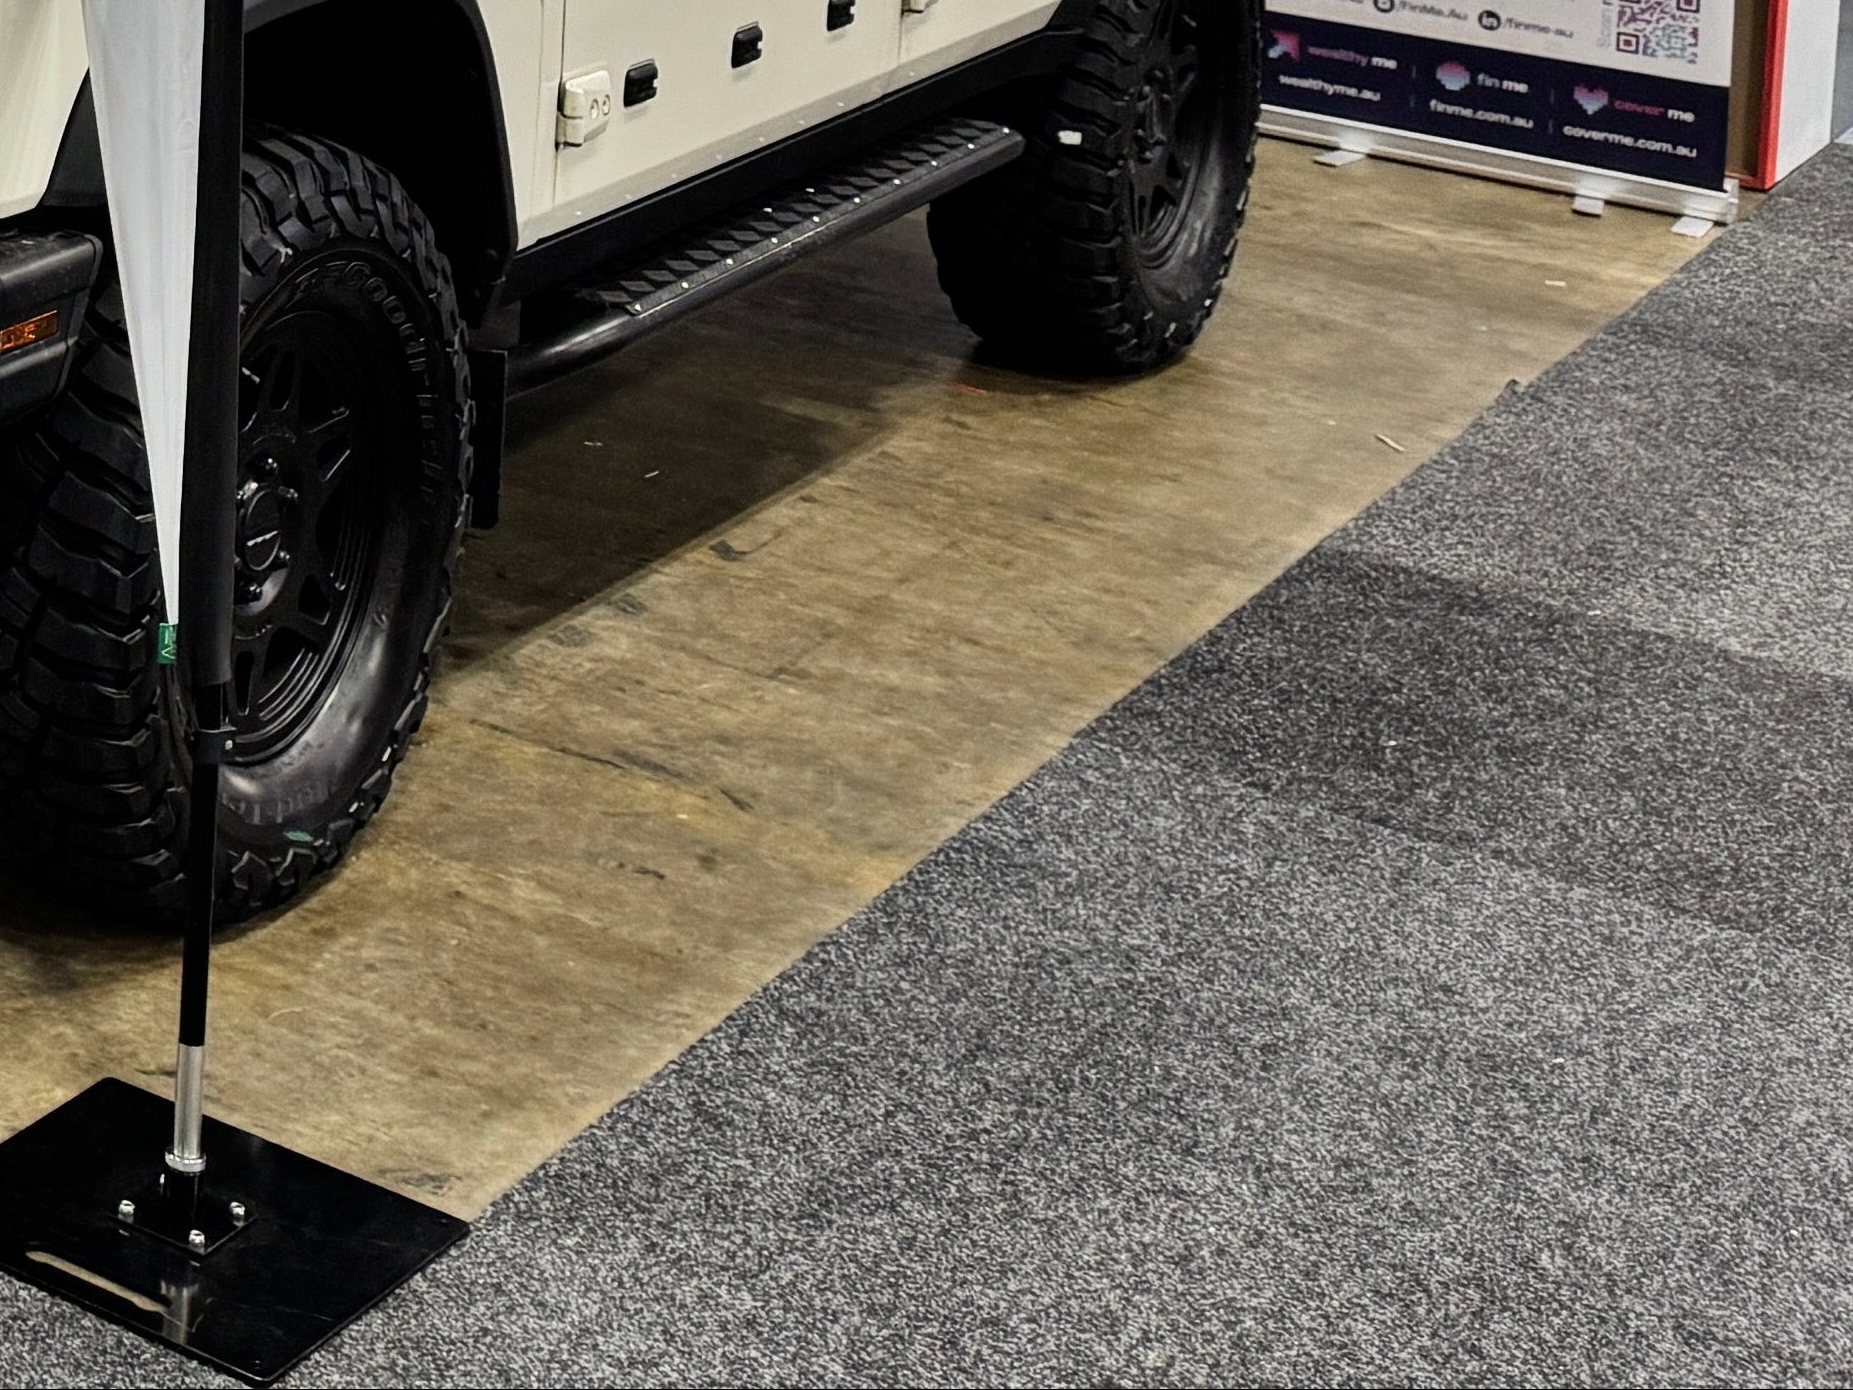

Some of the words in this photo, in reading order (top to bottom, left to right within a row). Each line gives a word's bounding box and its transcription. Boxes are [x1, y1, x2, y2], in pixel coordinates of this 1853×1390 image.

[1370, 56, 1398, 70] me
[1476, 72, 1500, 88] fin
[1501, 79, 1529, 94] me
[1429, 98, 1535, 129] finme.com.au
[1667, 109, 1695, 123] me
[1563, 124, 1697, 158] coverme.com.au
